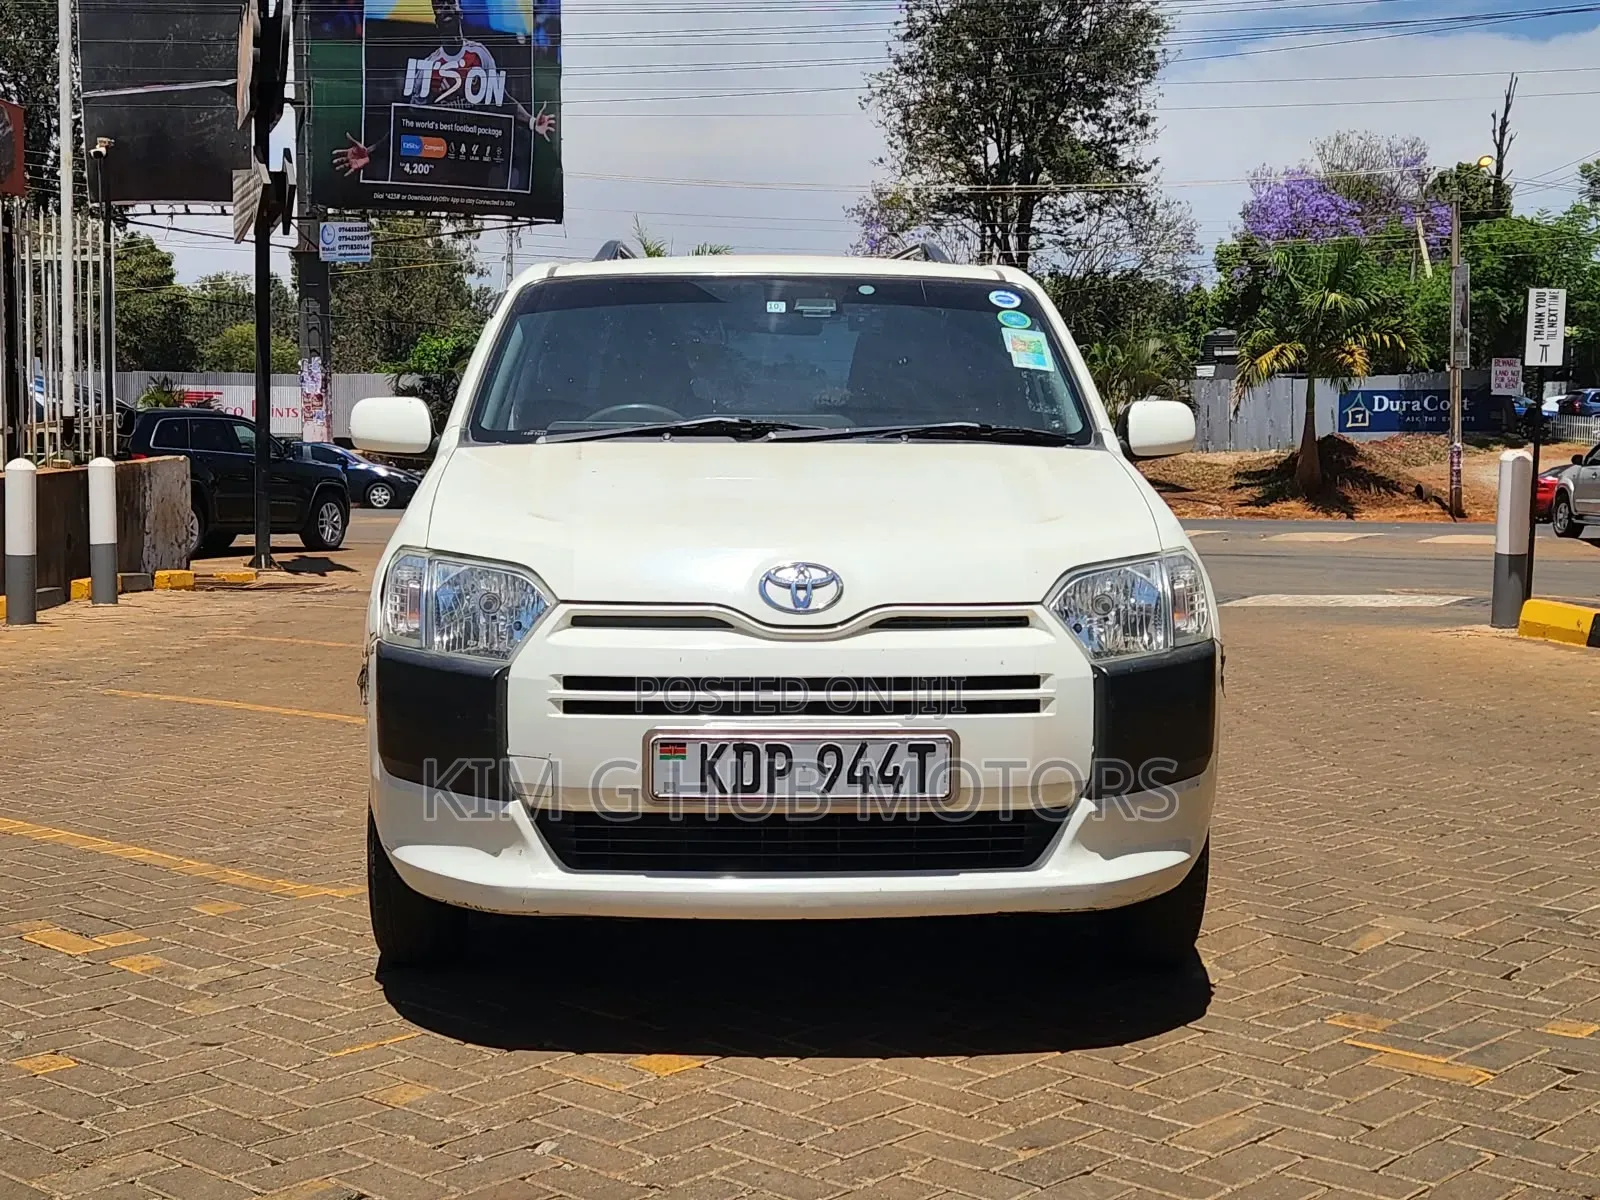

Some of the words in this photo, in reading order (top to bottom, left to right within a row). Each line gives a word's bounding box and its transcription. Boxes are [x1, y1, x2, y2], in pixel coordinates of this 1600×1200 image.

[403, 58, 462, 104] IT'S
[465, 66, 506, 107] ON
[402, 118, 414, 128] The
[415, 121, 439, 130] world's
[440, 122, 454, 131] best
[454, 123, 477, 134] football
[477, 127, 503, 138] package
[403, 162, 430, 175] 4,200
[407, 194, 432, 202] Download
[450, 196, 460, 204] App
[1535, 291, 1547, 309] YOU
[1548, 291, 1560, 306] TIME
[1533, 311, 1546, 342] THANK
[1547, 308, 1559, 328] NEXT
[1546, 329, 1558, 341] TILL
[1494, 358, 1518, 368] BEWARE
[1373, 395, 1470, 412] DuraCot
[700, 741, 794, 795] KDP
[815, 741, 937, 795] 944T
